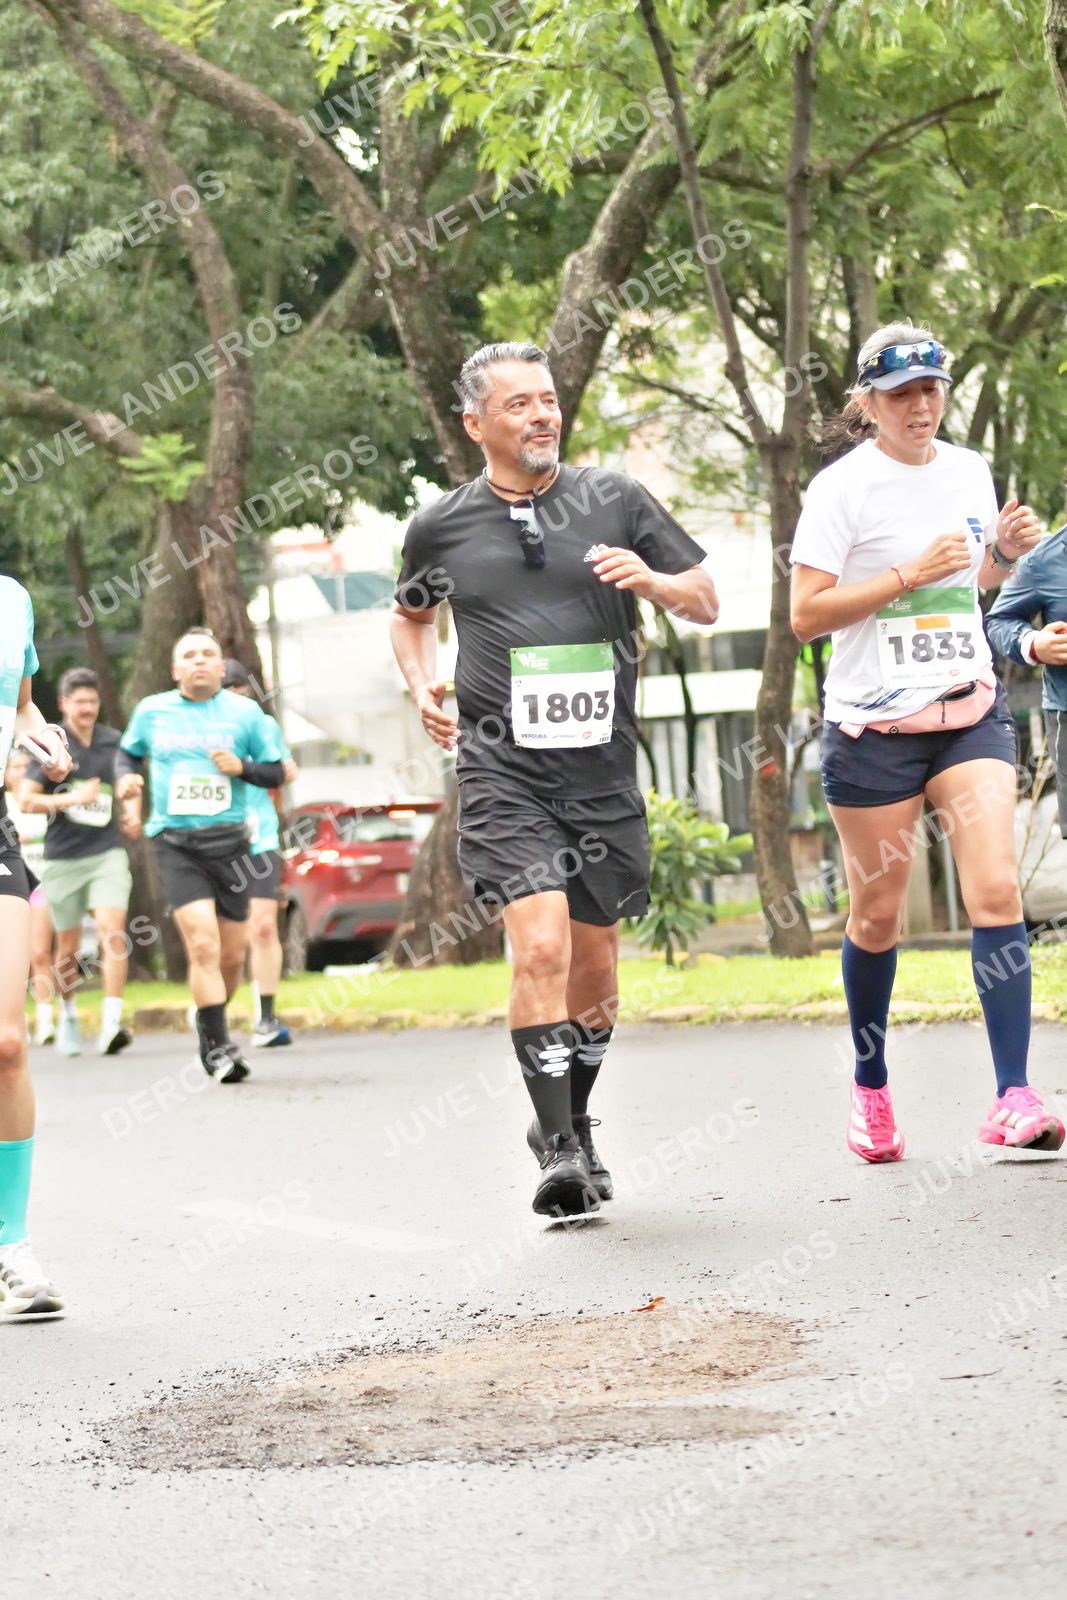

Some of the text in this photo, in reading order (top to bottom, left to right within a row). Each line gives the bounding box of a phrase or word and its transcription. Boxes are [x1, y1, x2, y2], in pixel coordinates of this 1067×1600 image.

[888, 631, 976, 665] 1833
[522, 689, 611, 724] 1803
[175, 785, 226, 801] 2505
